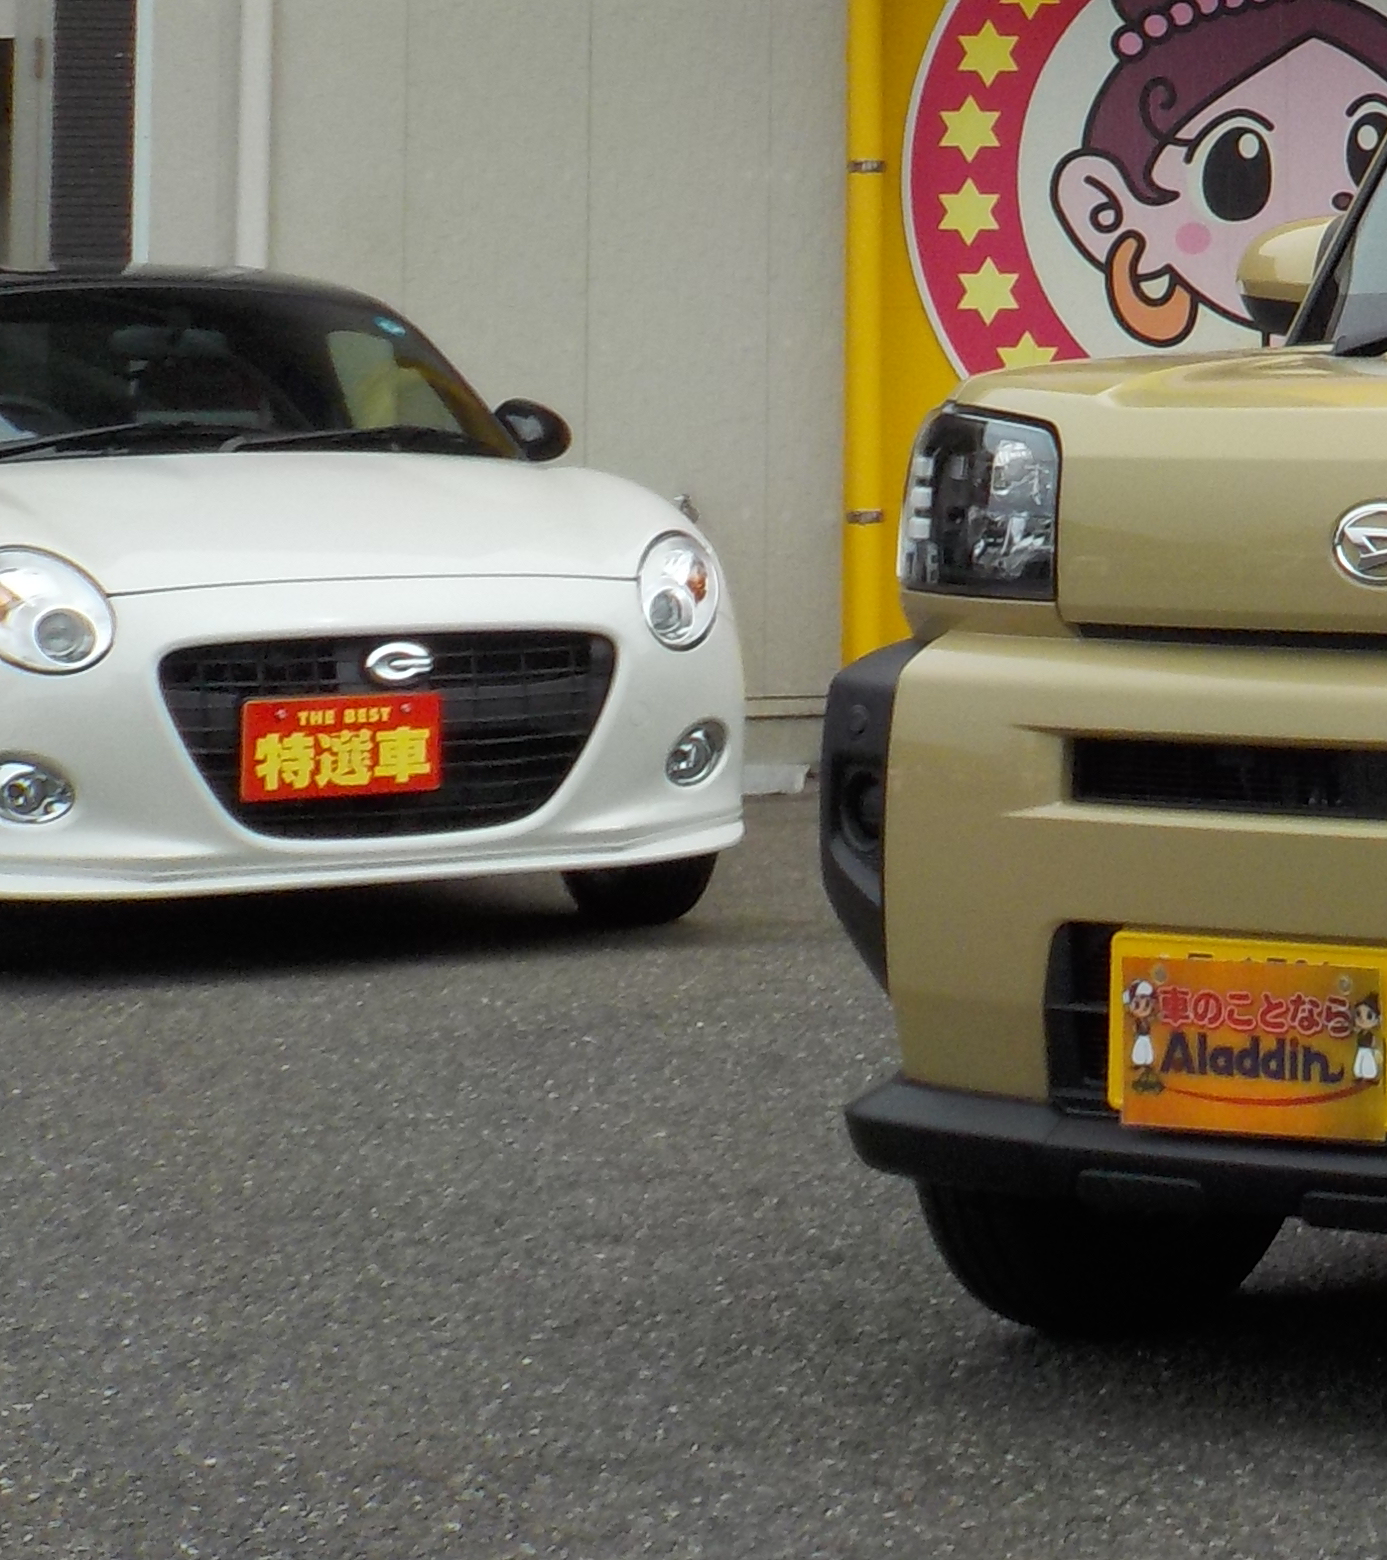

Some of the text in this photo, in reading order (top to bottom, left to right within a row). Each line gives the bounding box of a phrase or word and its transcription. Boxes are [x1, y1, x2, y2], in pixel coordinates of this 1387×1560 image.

[297, 706, 392, 726] THE BEST
[254, 726, 431, 791] 特選車
[1157, 985, 1350, 1038] 車のことなら
[1160, 1030, 1345, 1083] Aladdin
